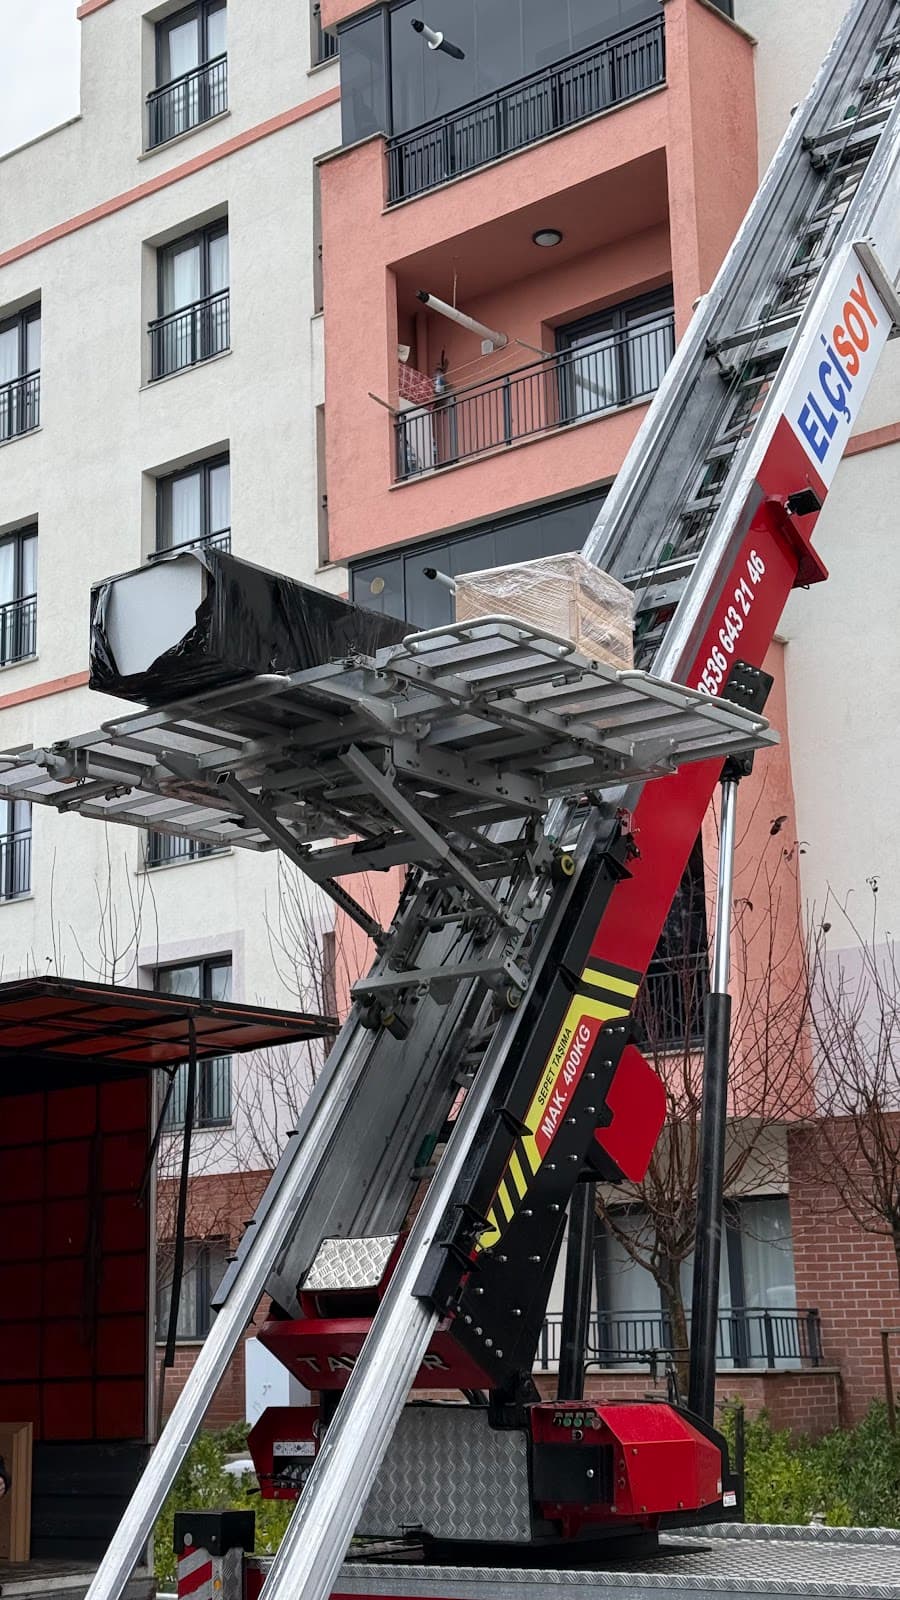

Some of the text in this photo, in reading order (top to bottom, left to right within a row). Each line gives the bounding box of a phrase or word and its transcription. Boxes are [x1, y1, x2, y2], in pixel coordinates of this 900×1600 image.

[718, 606, 744, 654] 643
[734, 577, 755, 617] 21
[746, 550, 766, 585] 46
[537, 1070, 556, 1105] SEPET
[540, 1024, 591, 1140] MAK. 400KG
